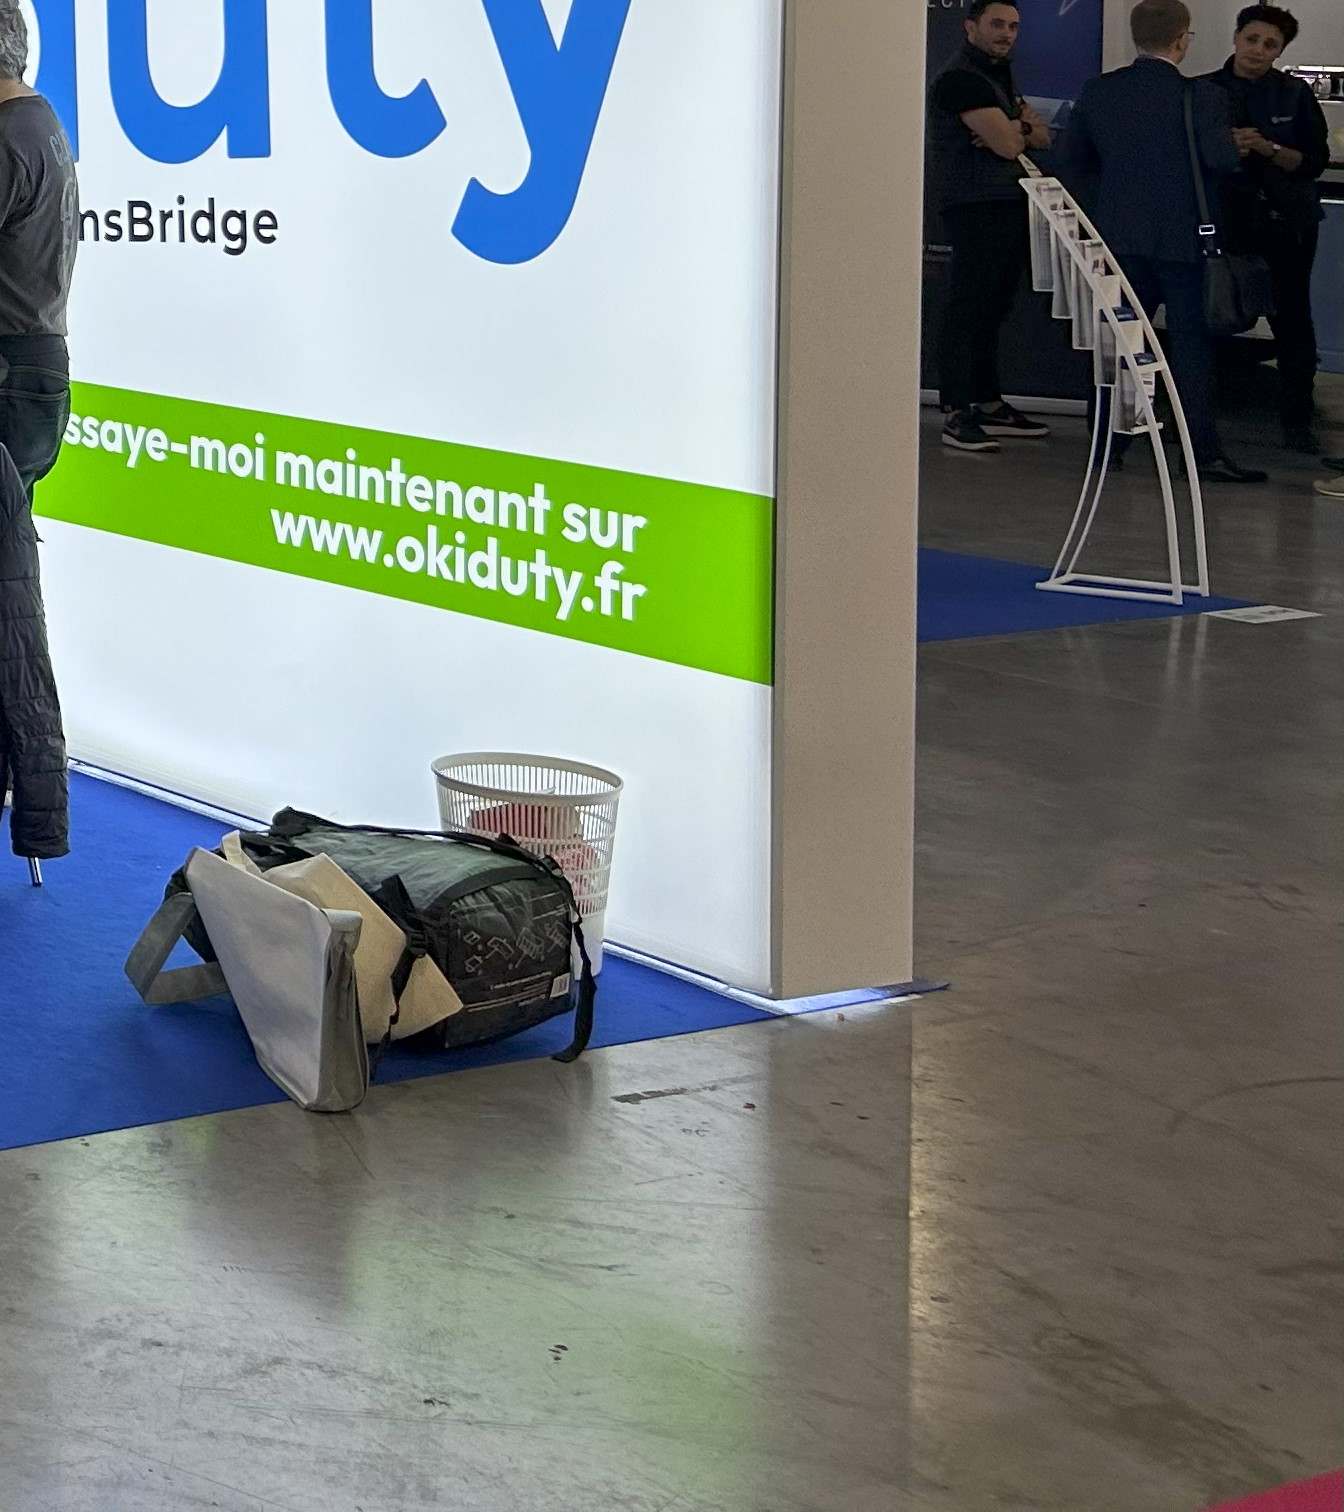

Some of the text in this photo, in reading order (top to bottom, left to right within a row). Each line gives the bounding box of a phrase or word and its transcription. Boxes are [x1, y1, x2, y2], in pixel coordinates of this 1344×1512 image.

[62, 411, 650, 554] ssaye-moi maintenant sur
[269, 507, 650, 622] www.okiduty.fr
